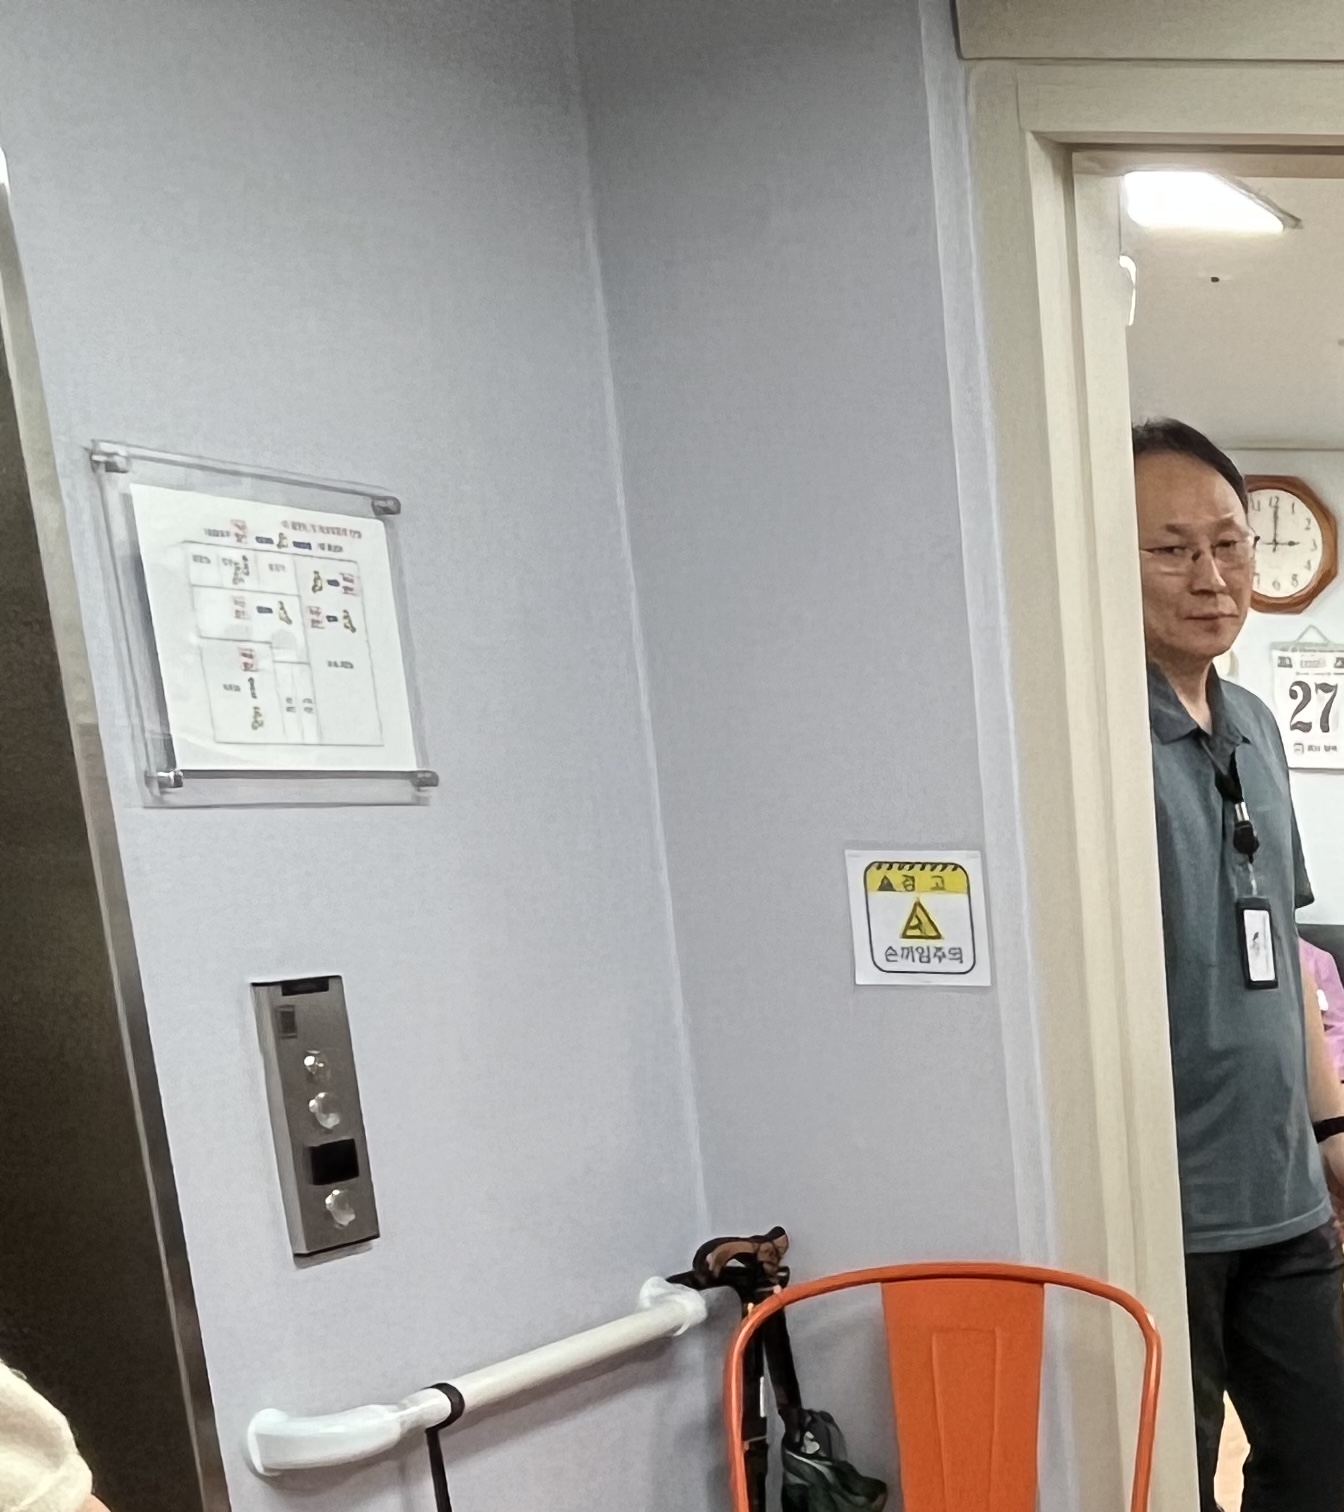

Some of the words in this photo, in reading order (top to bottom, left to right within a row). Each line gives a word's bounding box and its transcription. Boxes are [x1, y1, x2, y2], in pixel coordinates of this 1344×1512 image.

[1288, 680, 1338, 733] 27
[929, 875, 946, 892] 고
[884, 945, 964, 965] 손끼임주의
